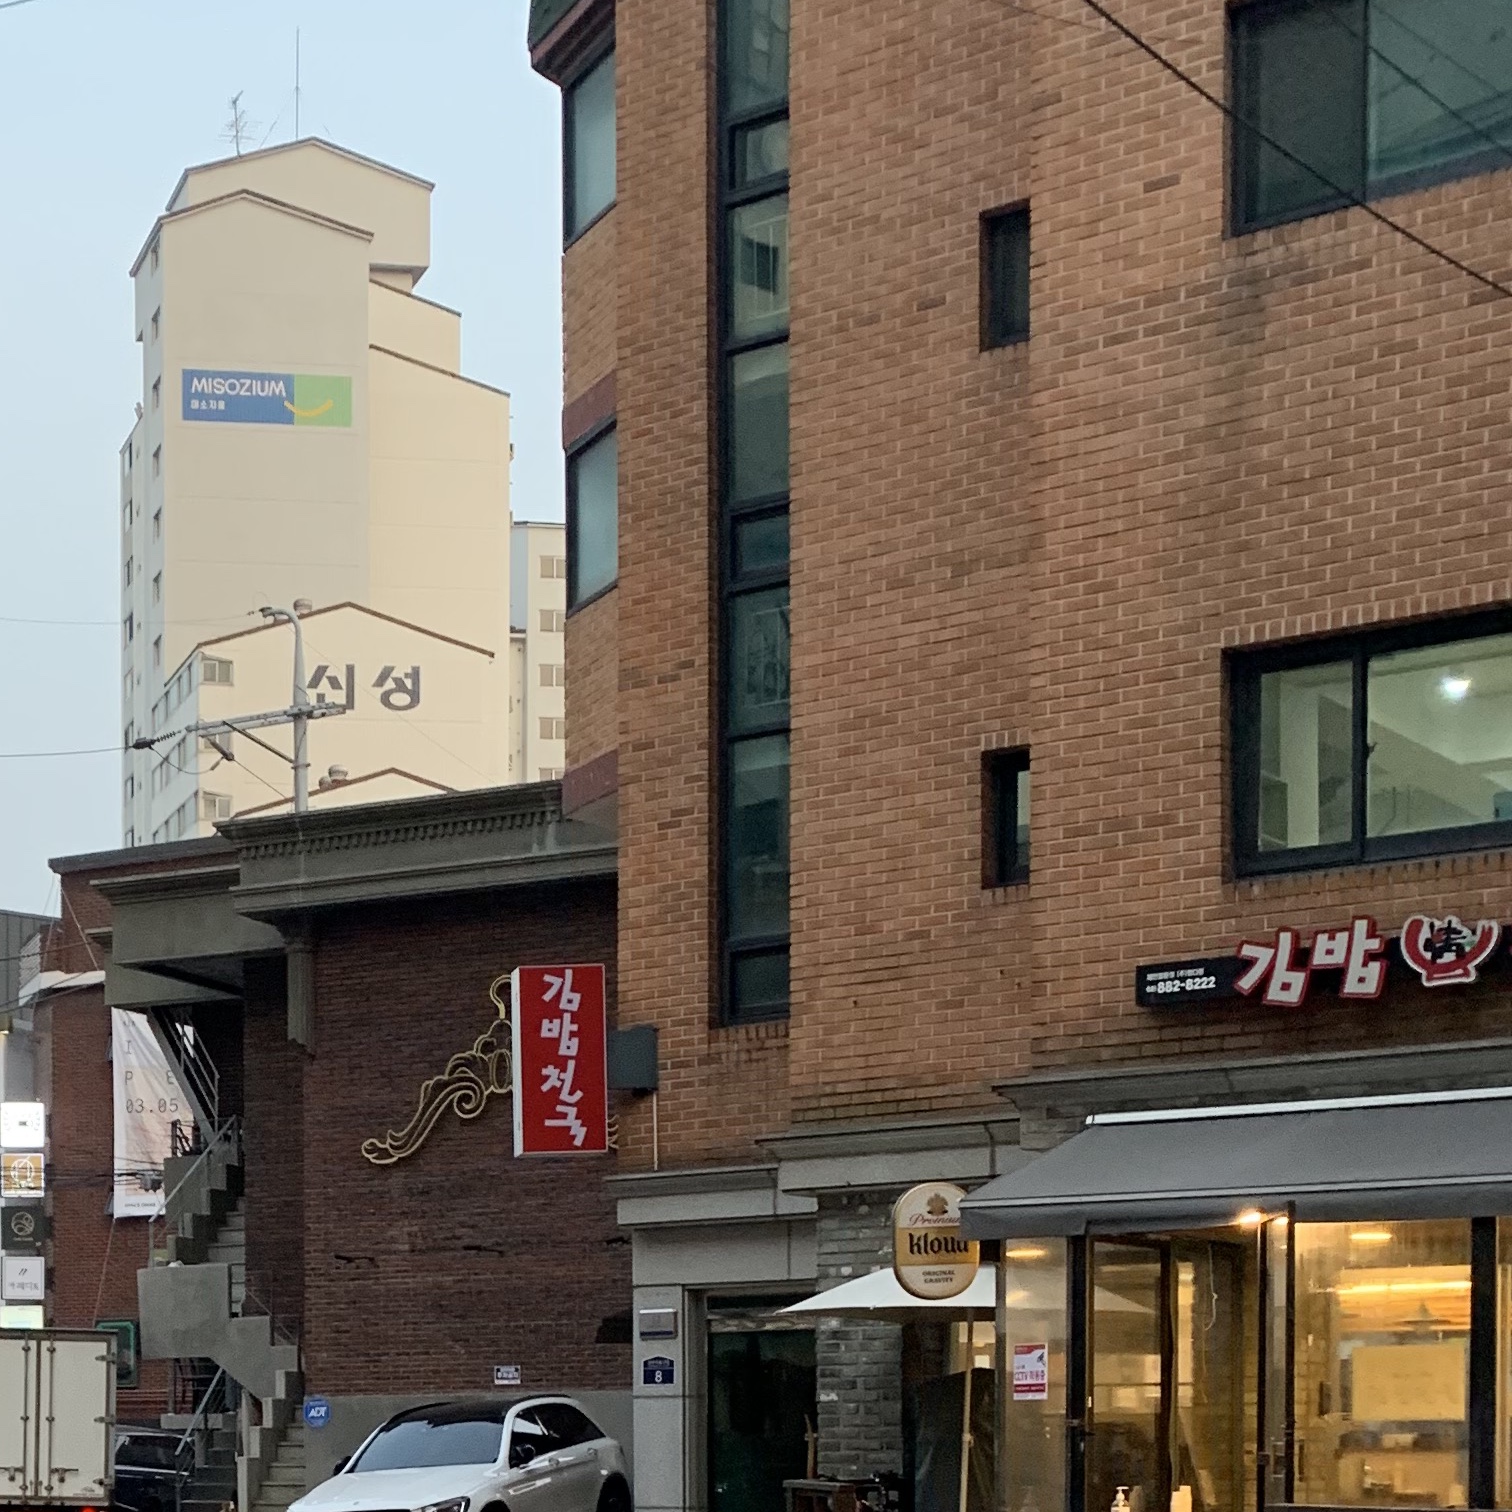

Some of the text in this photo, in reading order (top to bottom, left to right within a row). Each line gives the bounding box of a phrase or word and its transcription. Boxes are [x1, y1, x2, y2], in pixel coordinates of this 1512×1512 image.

[191, 377, 287, 397] MISOZIUM
[1157, 976, 1216, 994] 882-8222
[540, 968, 588, 1147] 김밥천국
[126, 1098, 179, 1114] 03.05
[654, 1370, 663, 1383] 8
[308, 1406, 327, 1417] ADT
